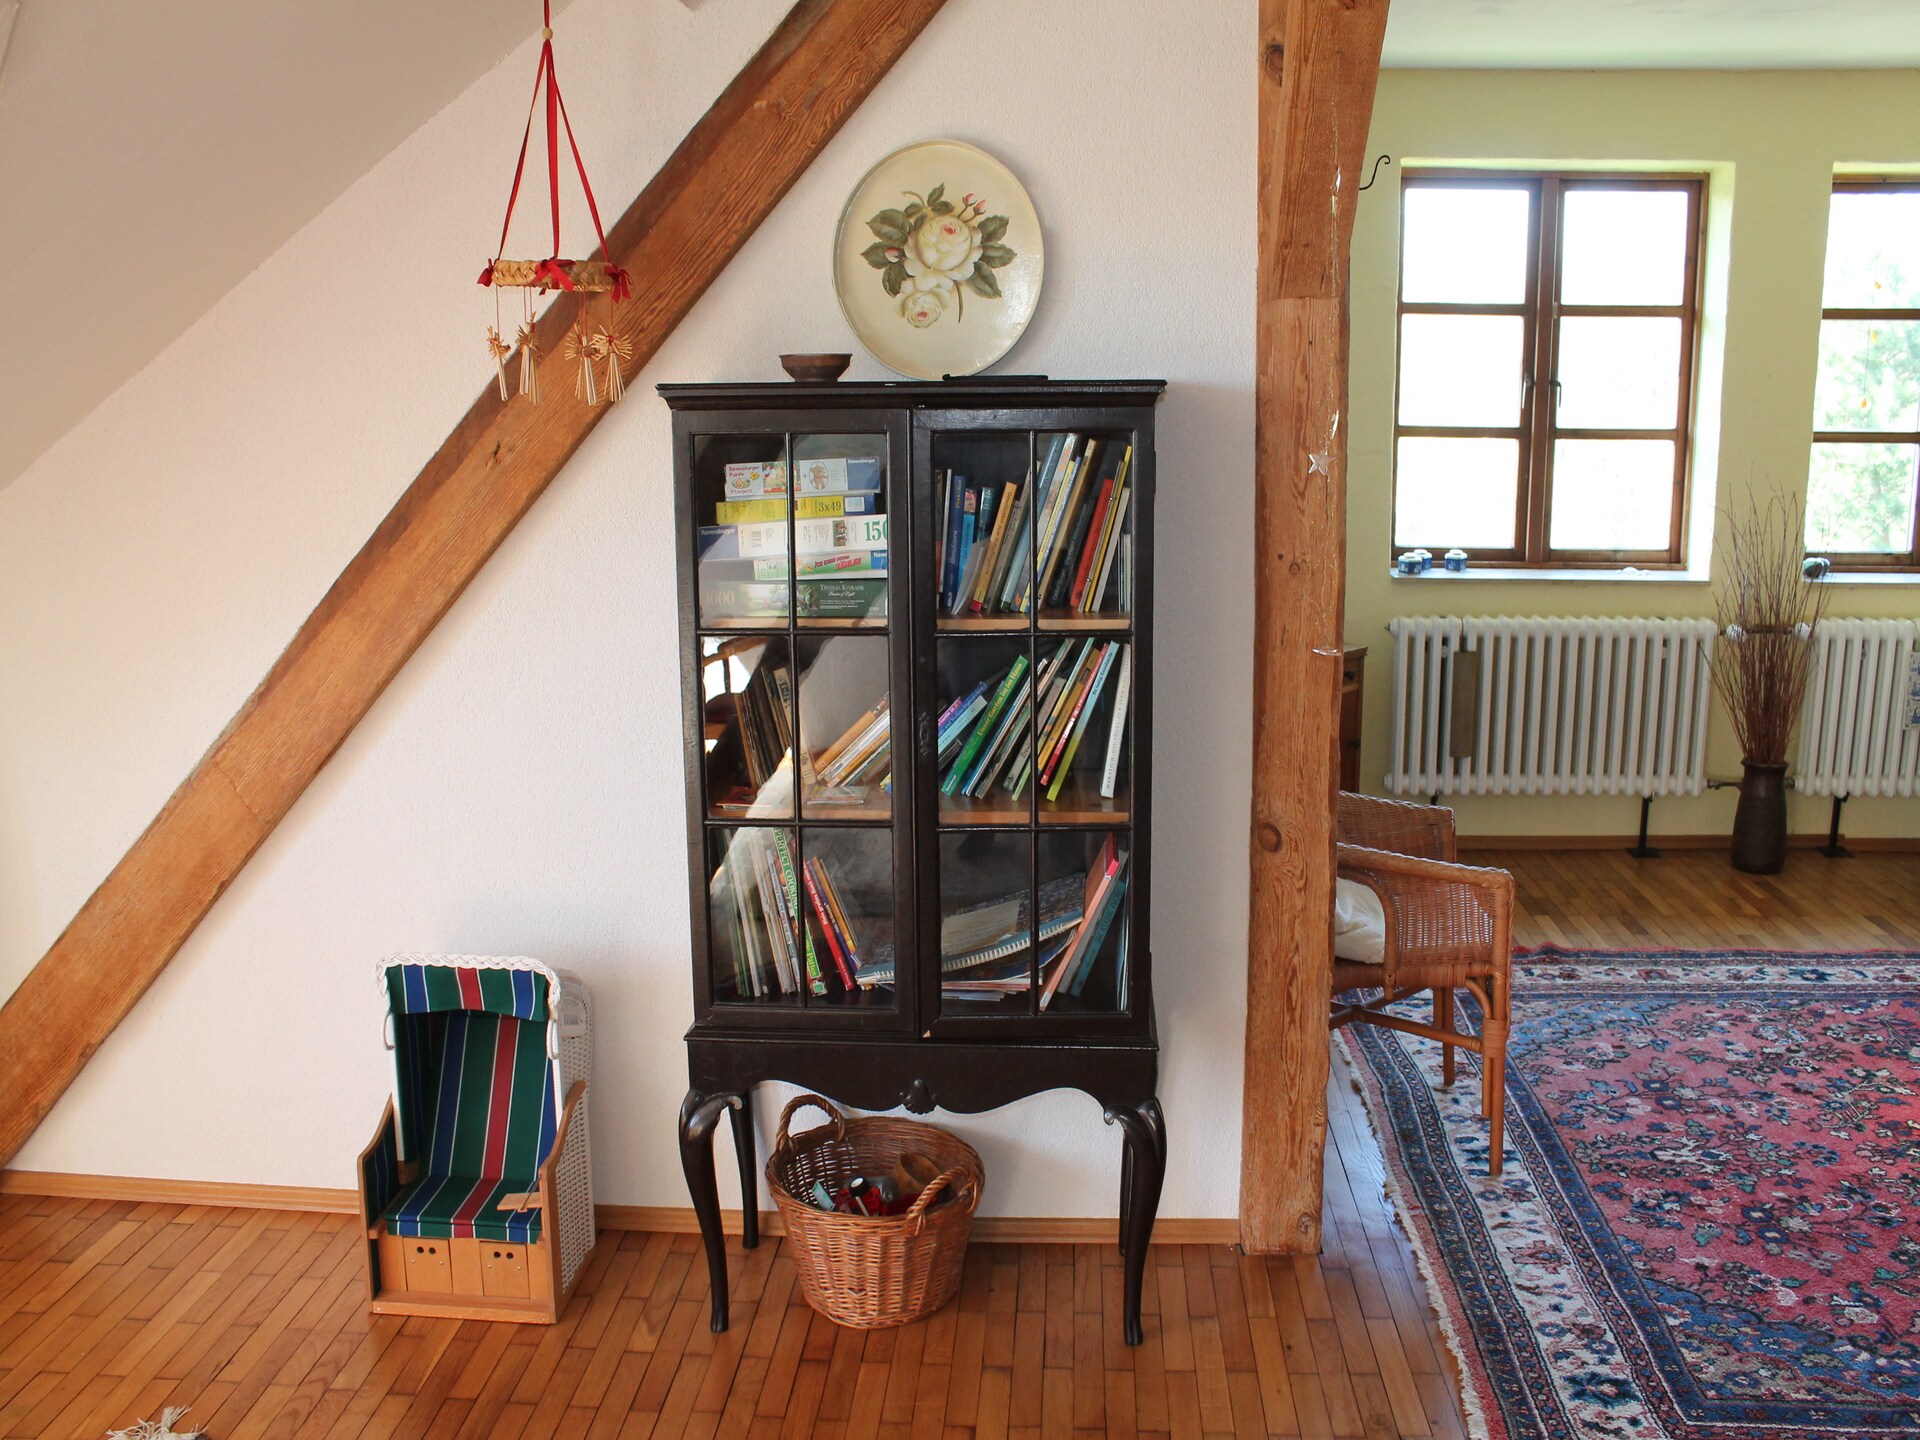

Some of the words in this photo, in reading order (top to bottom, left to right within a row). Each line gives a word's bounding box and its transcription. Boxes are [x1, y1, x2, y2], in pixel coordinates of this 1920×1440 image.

[818, 501, 842, 512] 3x49
[701, 528, 736, 536] Ravensburger
[706, 590, 735, 606] 1000
[978, 718, 990, 736] Unser
[988, 696, 1002, 717] Garten
[1010, 663, 1022, 680] Haus
[775, 829, 790, 867] PERFECT
